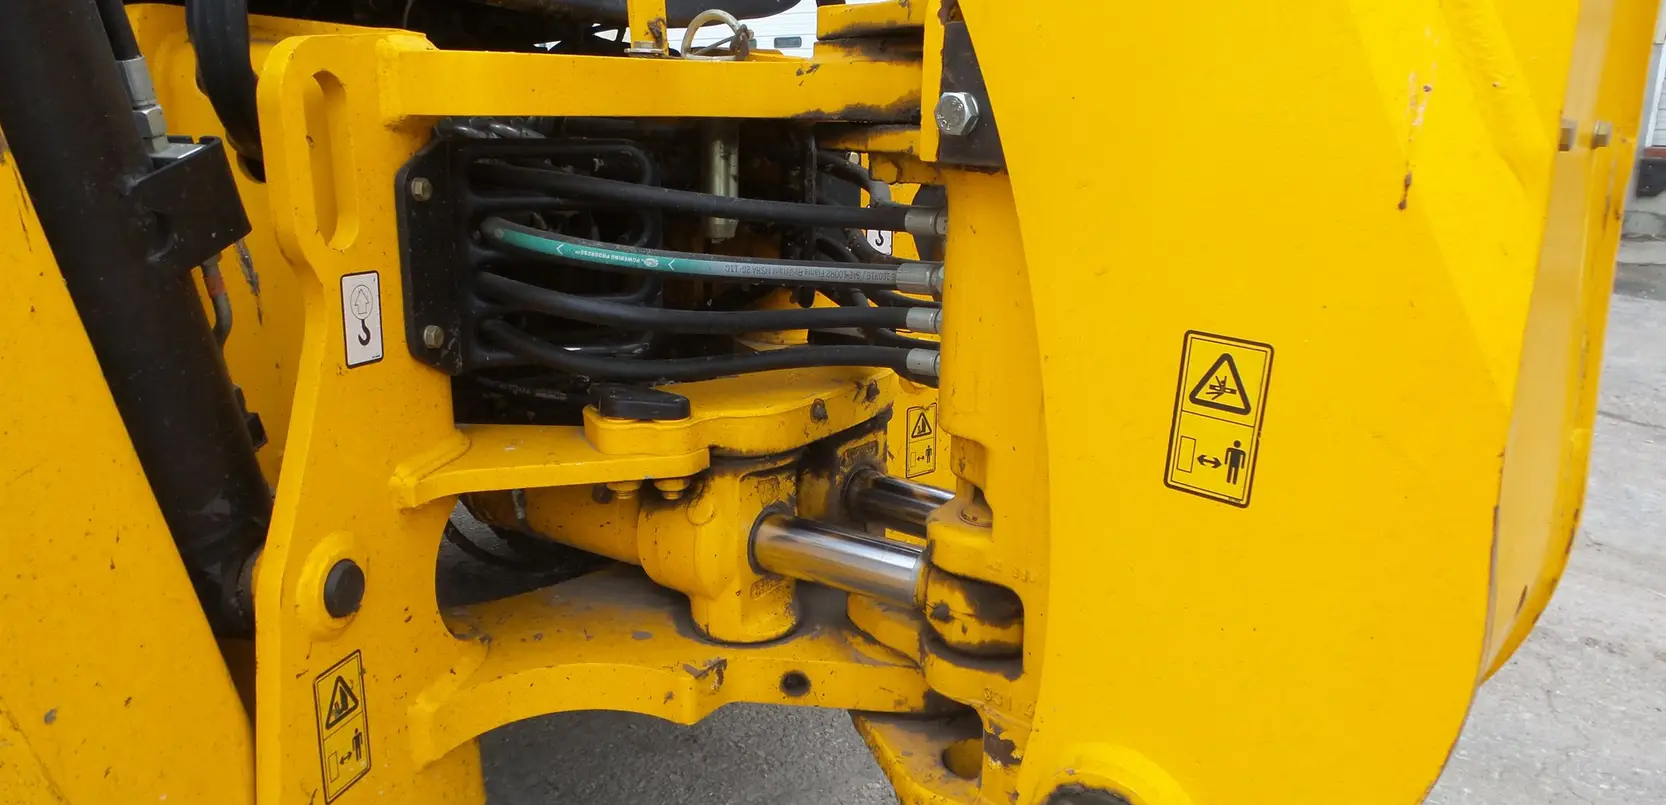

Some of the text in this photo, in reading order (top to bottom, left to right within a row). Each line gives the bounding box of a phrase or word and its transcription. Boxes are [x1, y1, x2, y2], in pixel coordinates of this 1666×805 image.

[611, 254, 640, 263] POWERING
[752, 266, 772, 276] MSHA
[772, 267, 803, 277] Resistant
[804, 268, 825, 278] Flame
